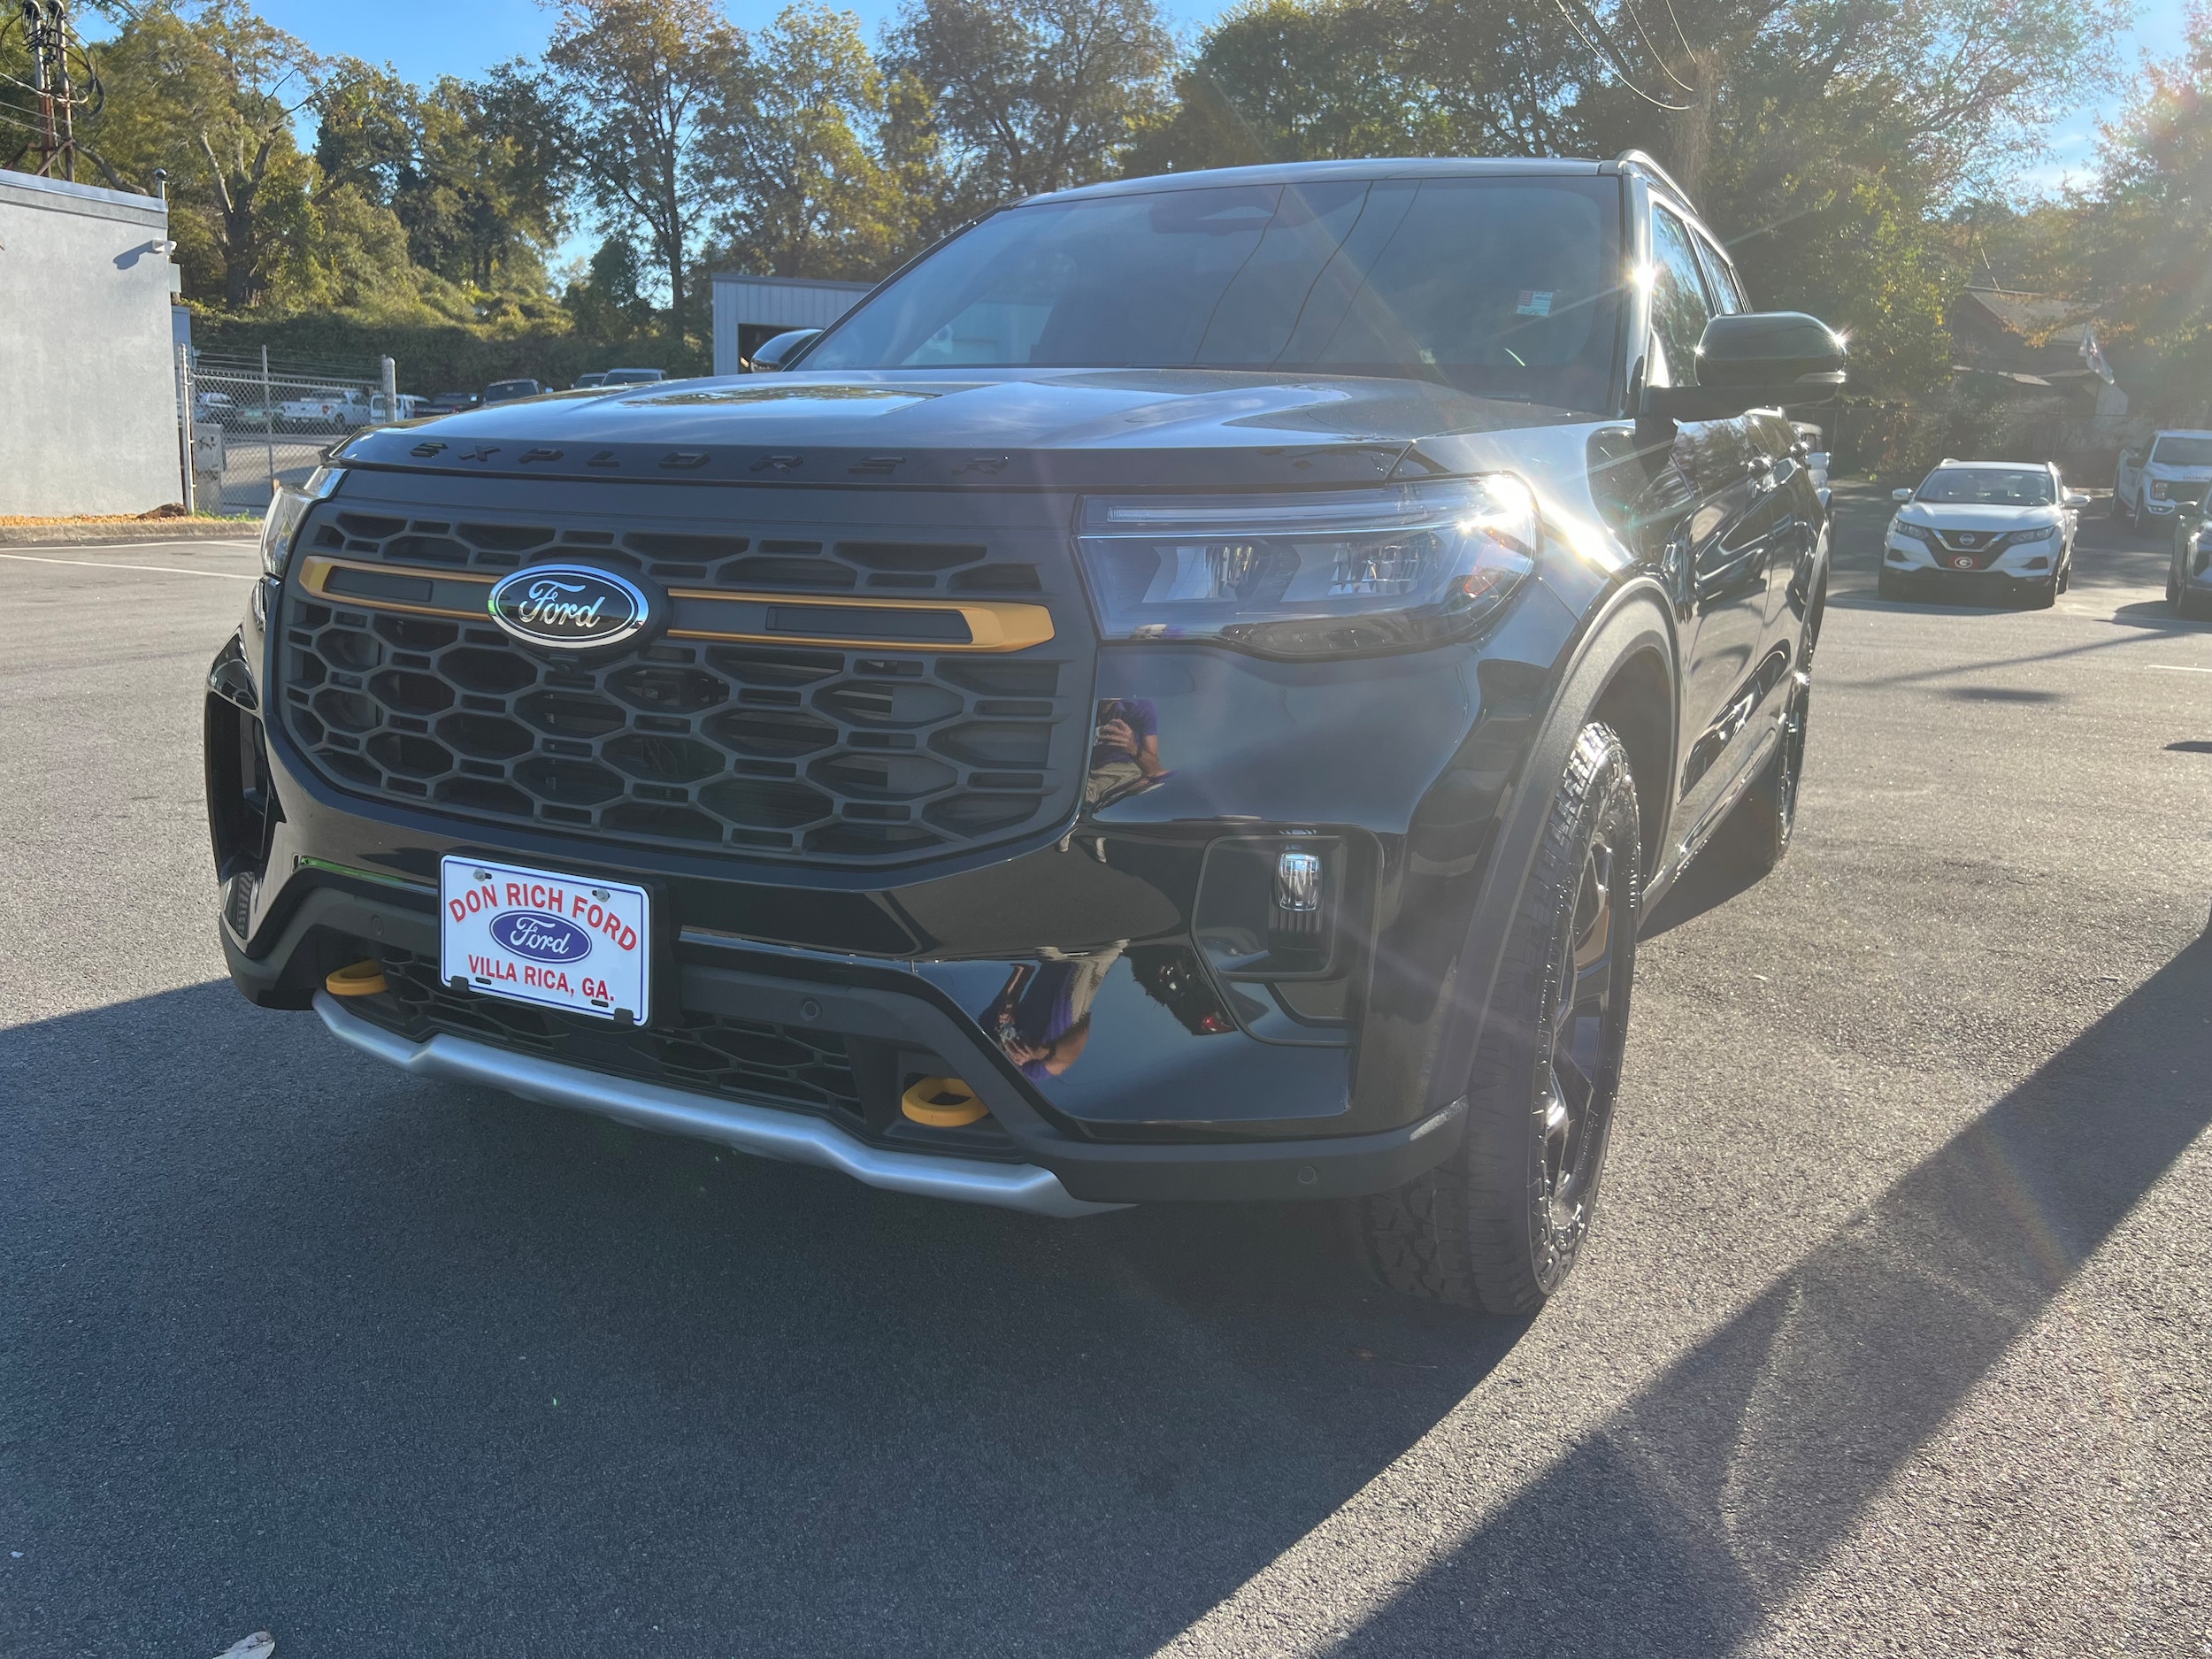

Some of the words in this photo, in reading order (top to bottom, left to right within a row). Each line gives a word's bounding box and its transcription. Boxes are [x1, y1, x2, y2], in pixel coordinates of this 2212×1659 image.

[410, 442, 1009, 474] EXPLORER
[518, 580, 606, 628] Ford
[449, 884, 498, 923] DON
[506, 883, 564, 913] RICH
[572, 895, 637, 951] FORD
[510, 917, 571, 954] Ford
[468, 954, 518, 982] VILLA
[524, 965, 575, 997] RICA,
[581, 977, 615, 1002] GA.
